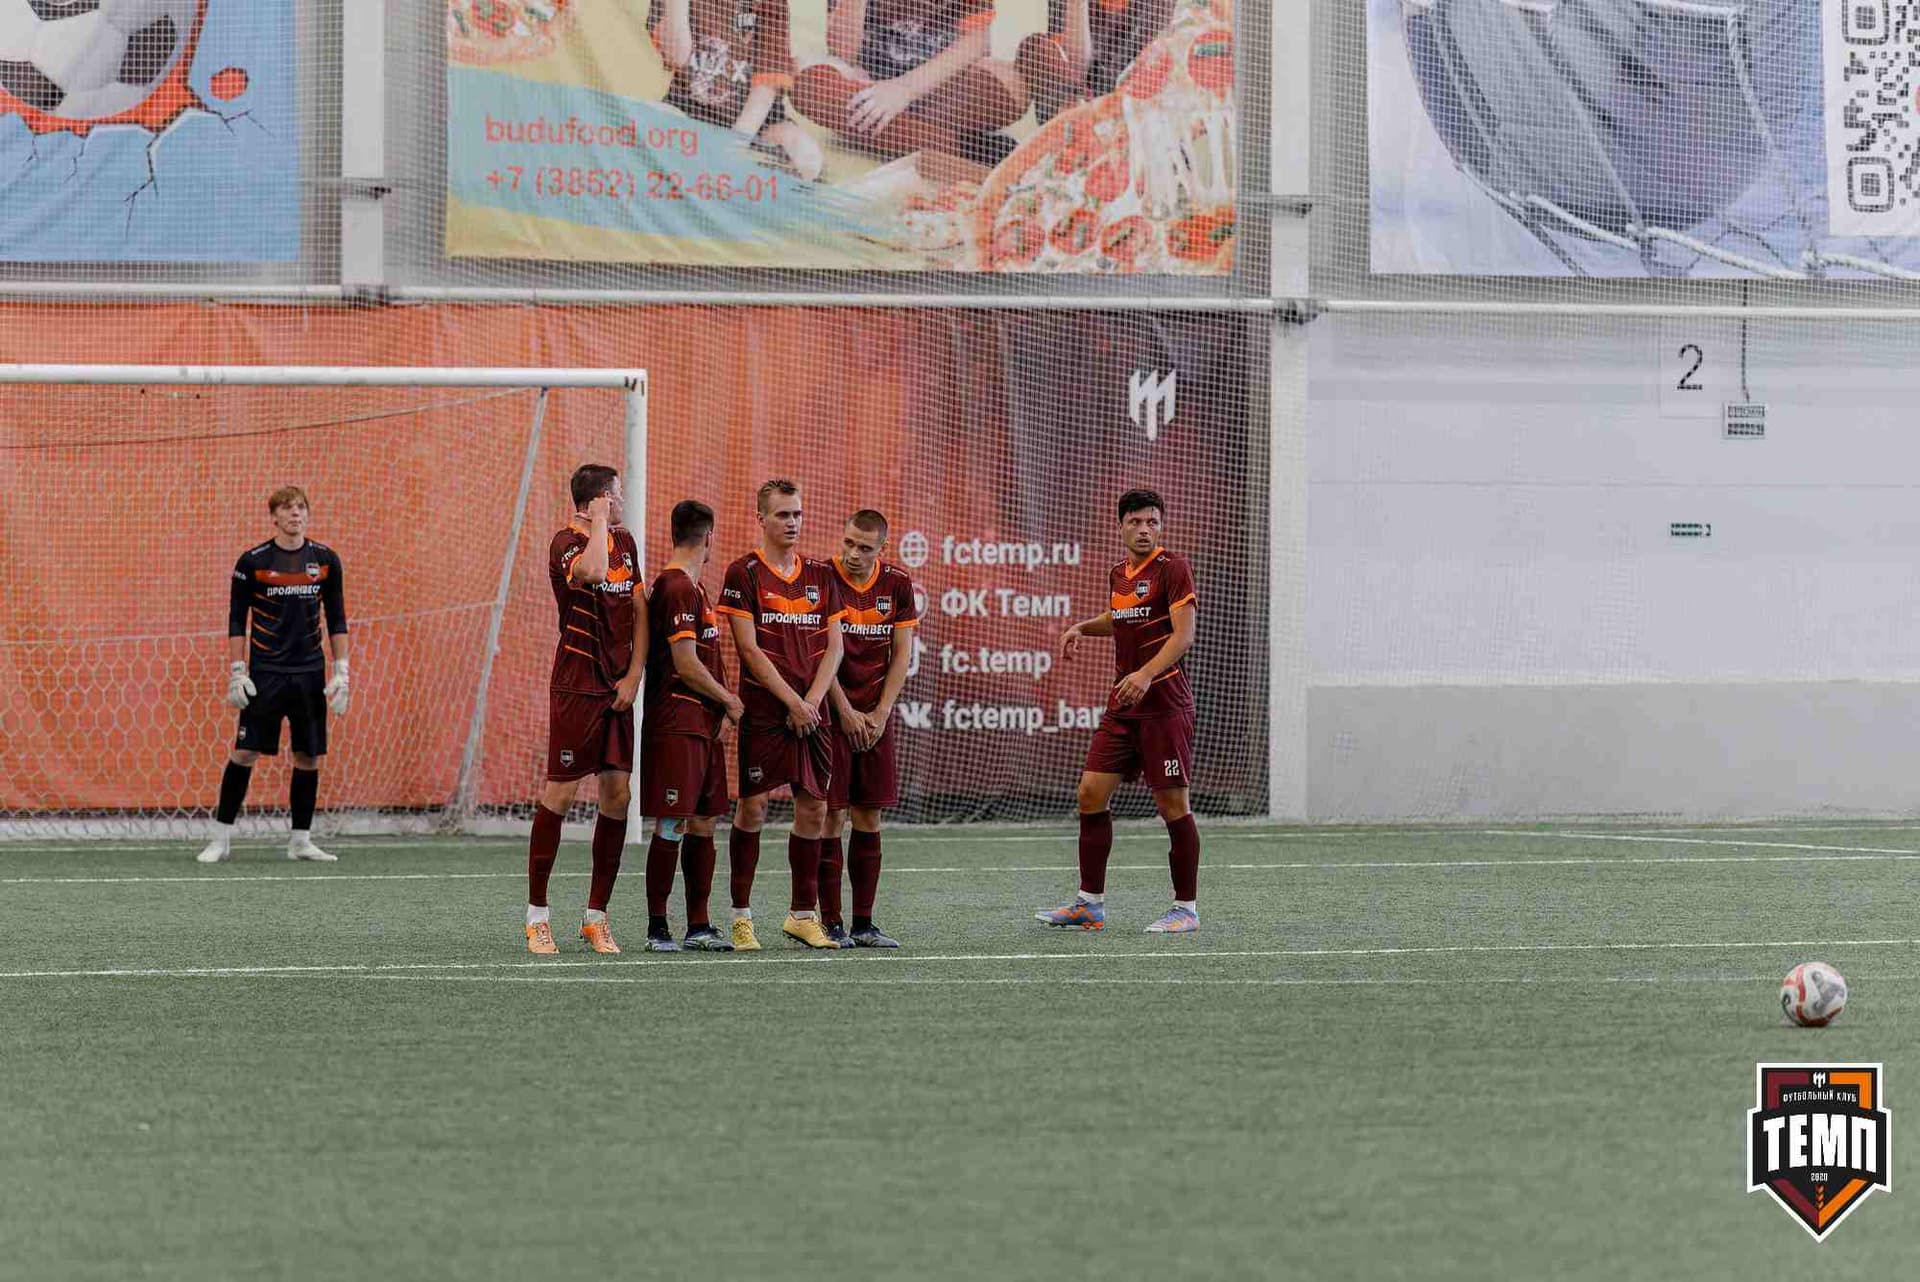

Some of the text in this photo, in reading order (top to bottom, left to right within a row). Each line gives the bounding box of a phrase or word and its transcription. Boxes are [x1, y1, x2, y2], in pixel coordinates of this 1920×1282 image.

[485, 115, 698, 156] budufood.org
[486, 165, 778, 202] +7 (3852) 22-66-01
[1677, 343, 1703, 390] 2
[942, 535, 1081, 572] fctemp.ru
[761, 612, 822, 625] ПРОДИНВЕСТ
[940, 588, 1072, 618] ФК Темп
[841, 622, 893, 635] ОДИНВЕСТ
[940, 644, 1052, 681] fc.temp
[942, 698, 1106, 736] fctemp_bar
[1164, 759, 1180, 777] 22
